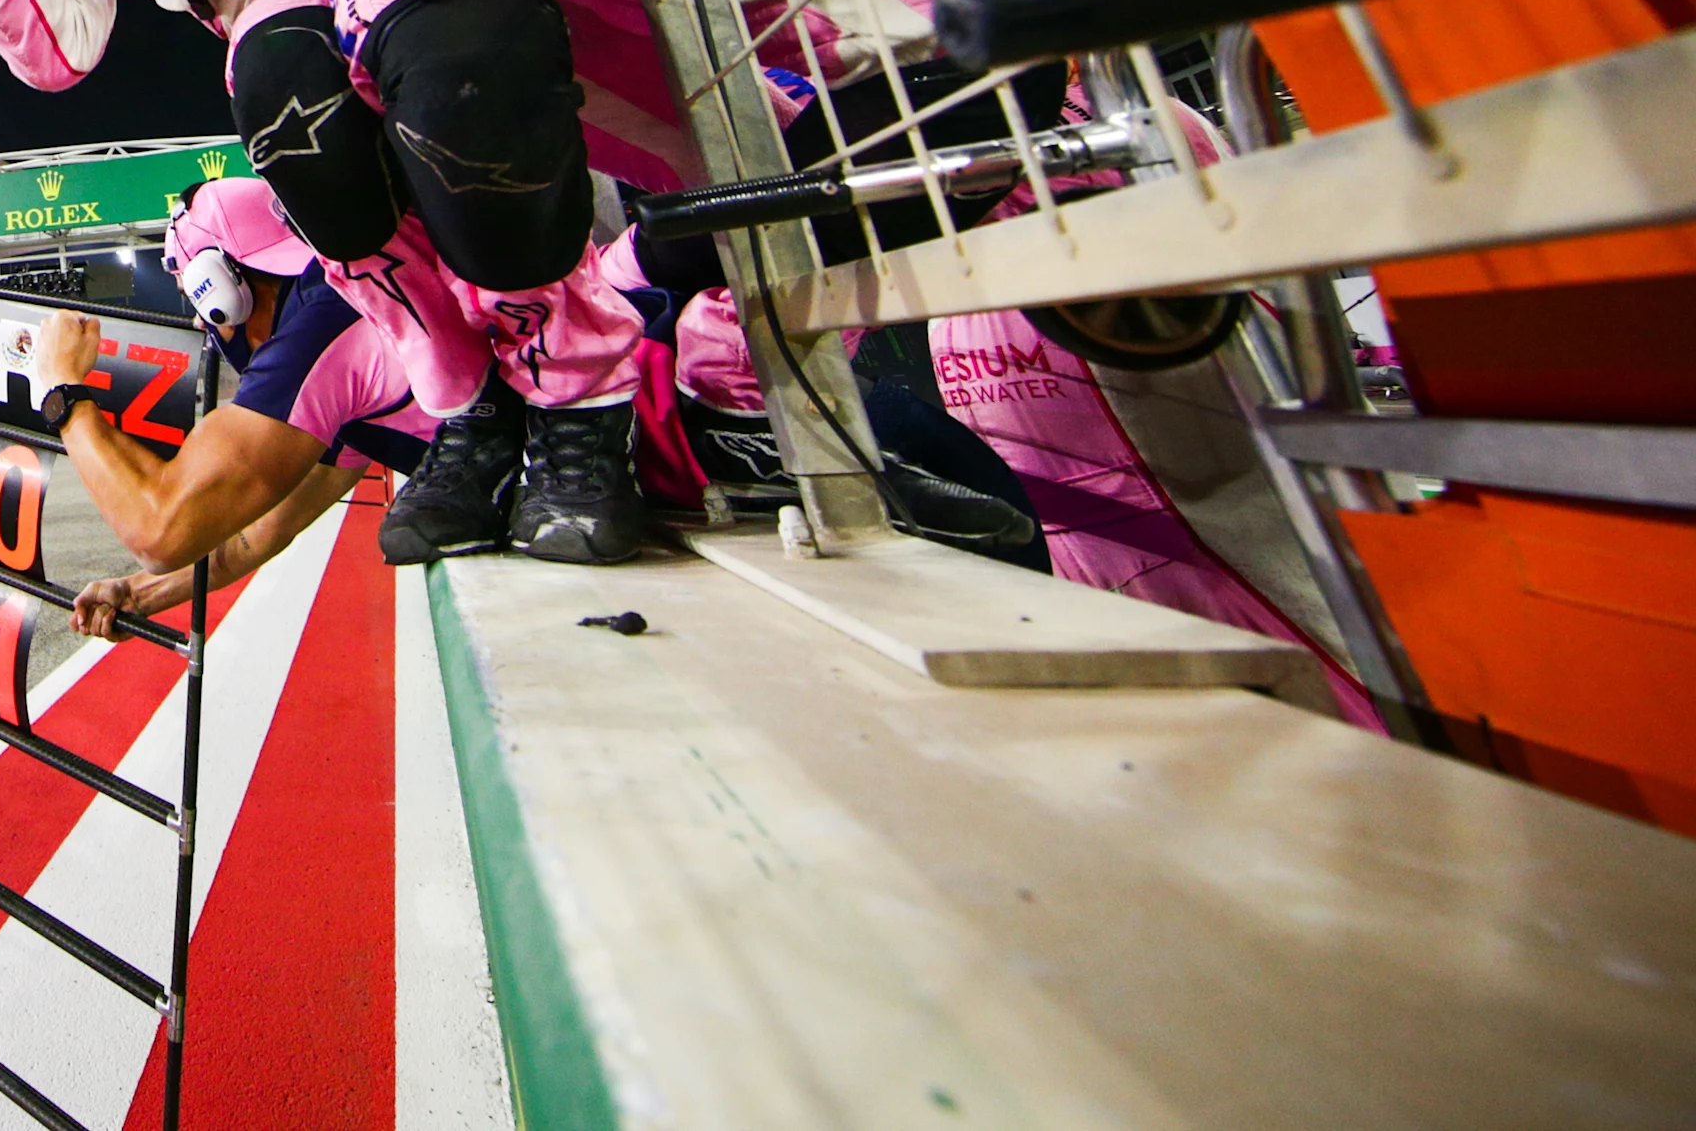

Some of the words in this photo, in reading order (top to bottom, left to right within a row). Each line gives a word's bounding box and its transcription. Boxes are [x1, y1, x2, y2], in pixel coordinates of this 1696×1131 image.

[6, 202, 102, 232] ROLEX
[192, 277, 213, 300] BWT
[972, 378, 1067, 404] WATER
